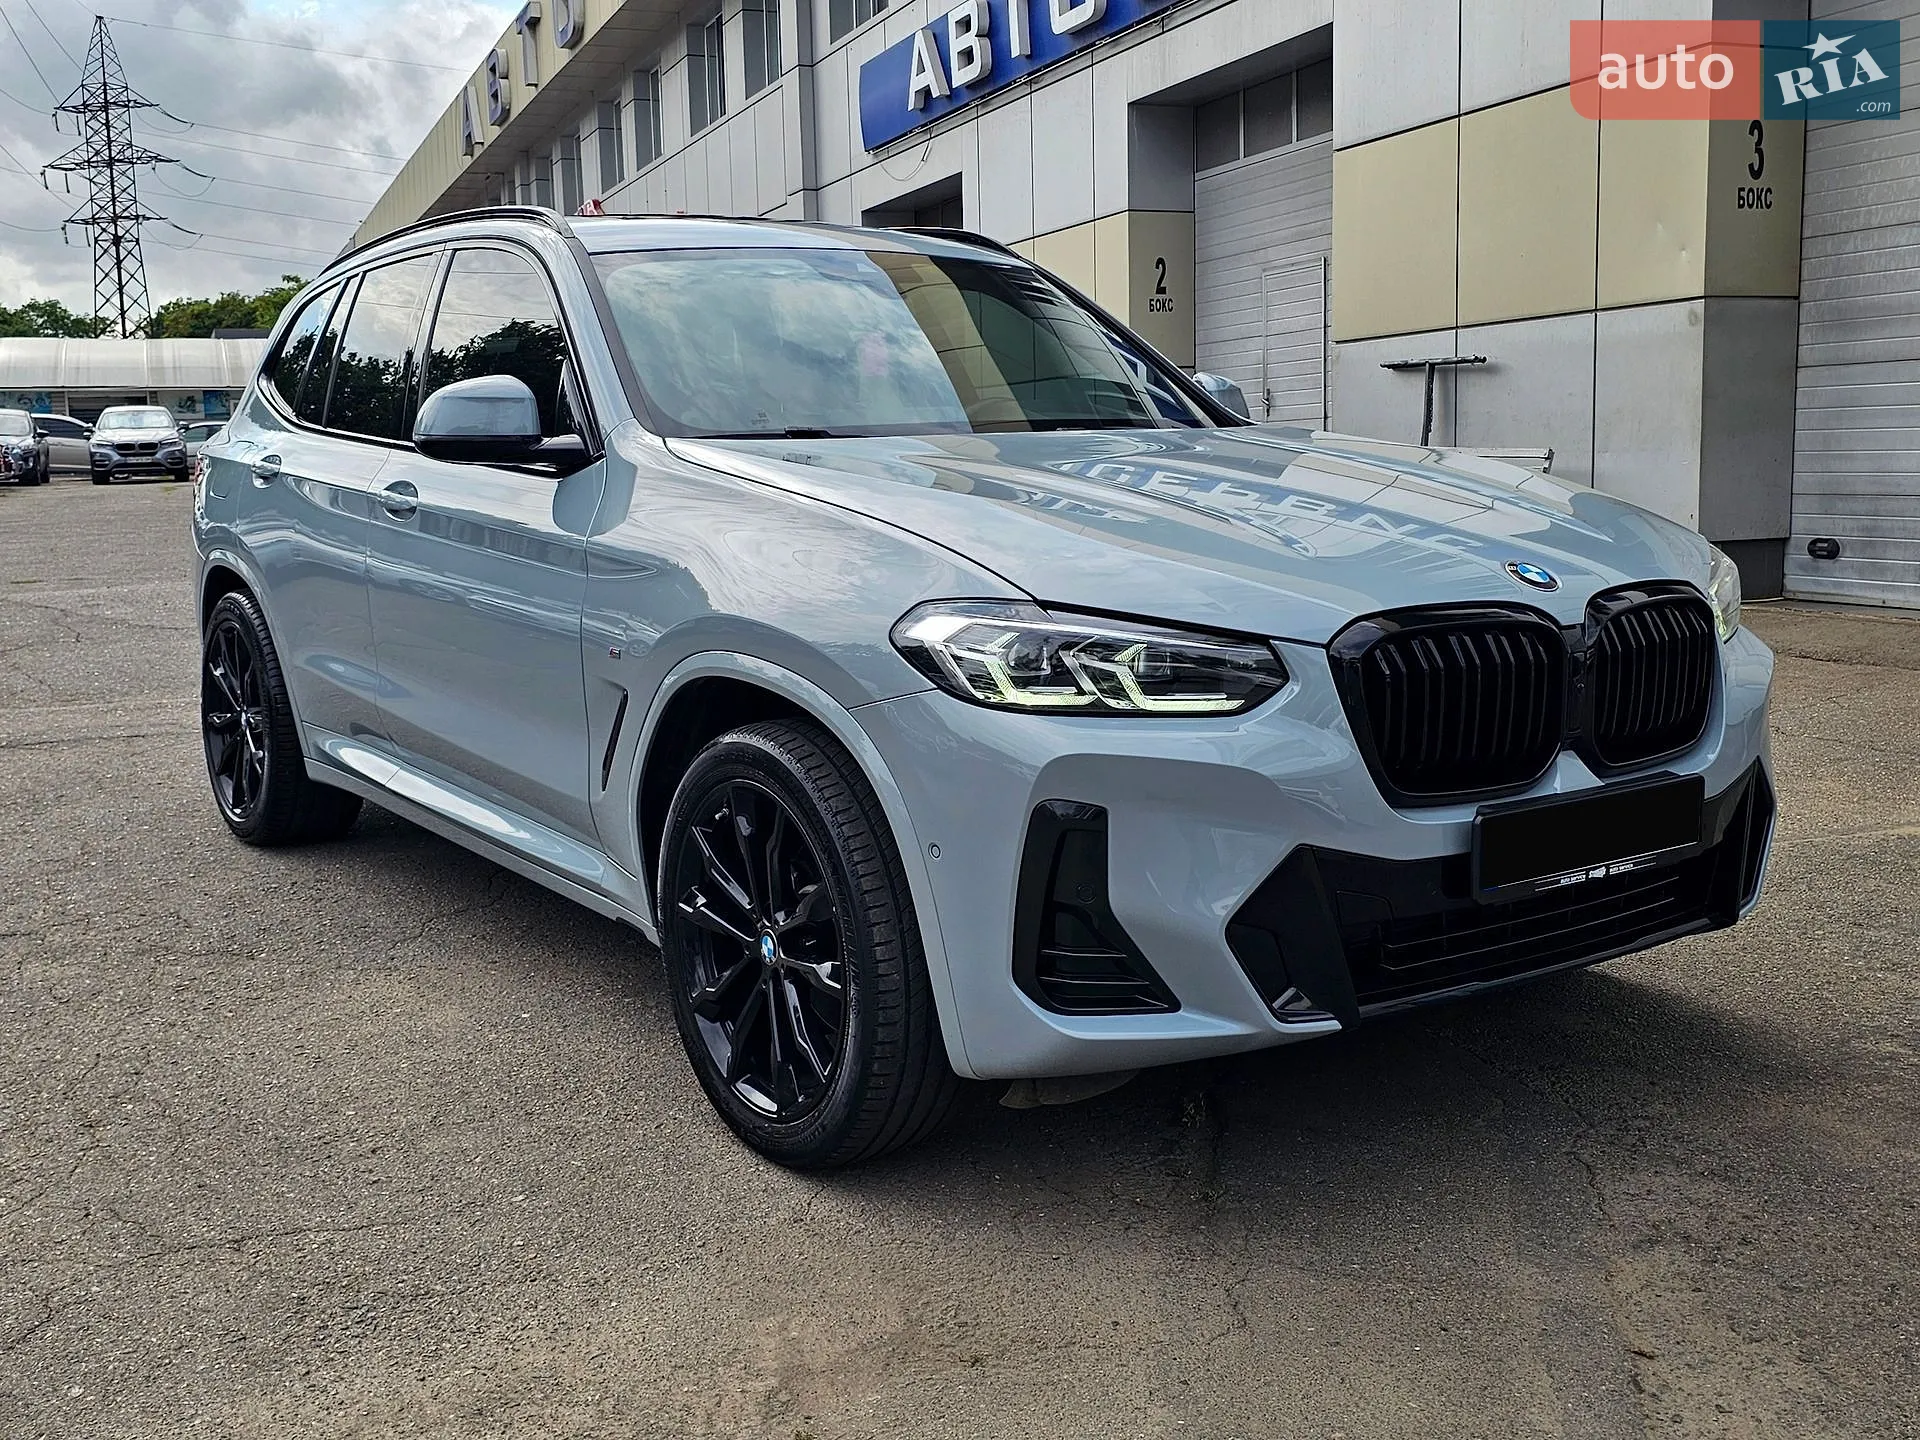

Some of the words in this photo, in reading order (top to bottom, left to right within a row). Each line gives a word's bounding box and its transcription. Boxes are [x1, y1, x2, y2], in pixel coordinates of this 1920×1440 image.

[1748, 120, 1765, 180] 3
[1737, 187, 1773, 209] БОКС
[1155, 257, 1167, 294] 2
[1149, 298, 1174, 312] БОКС
